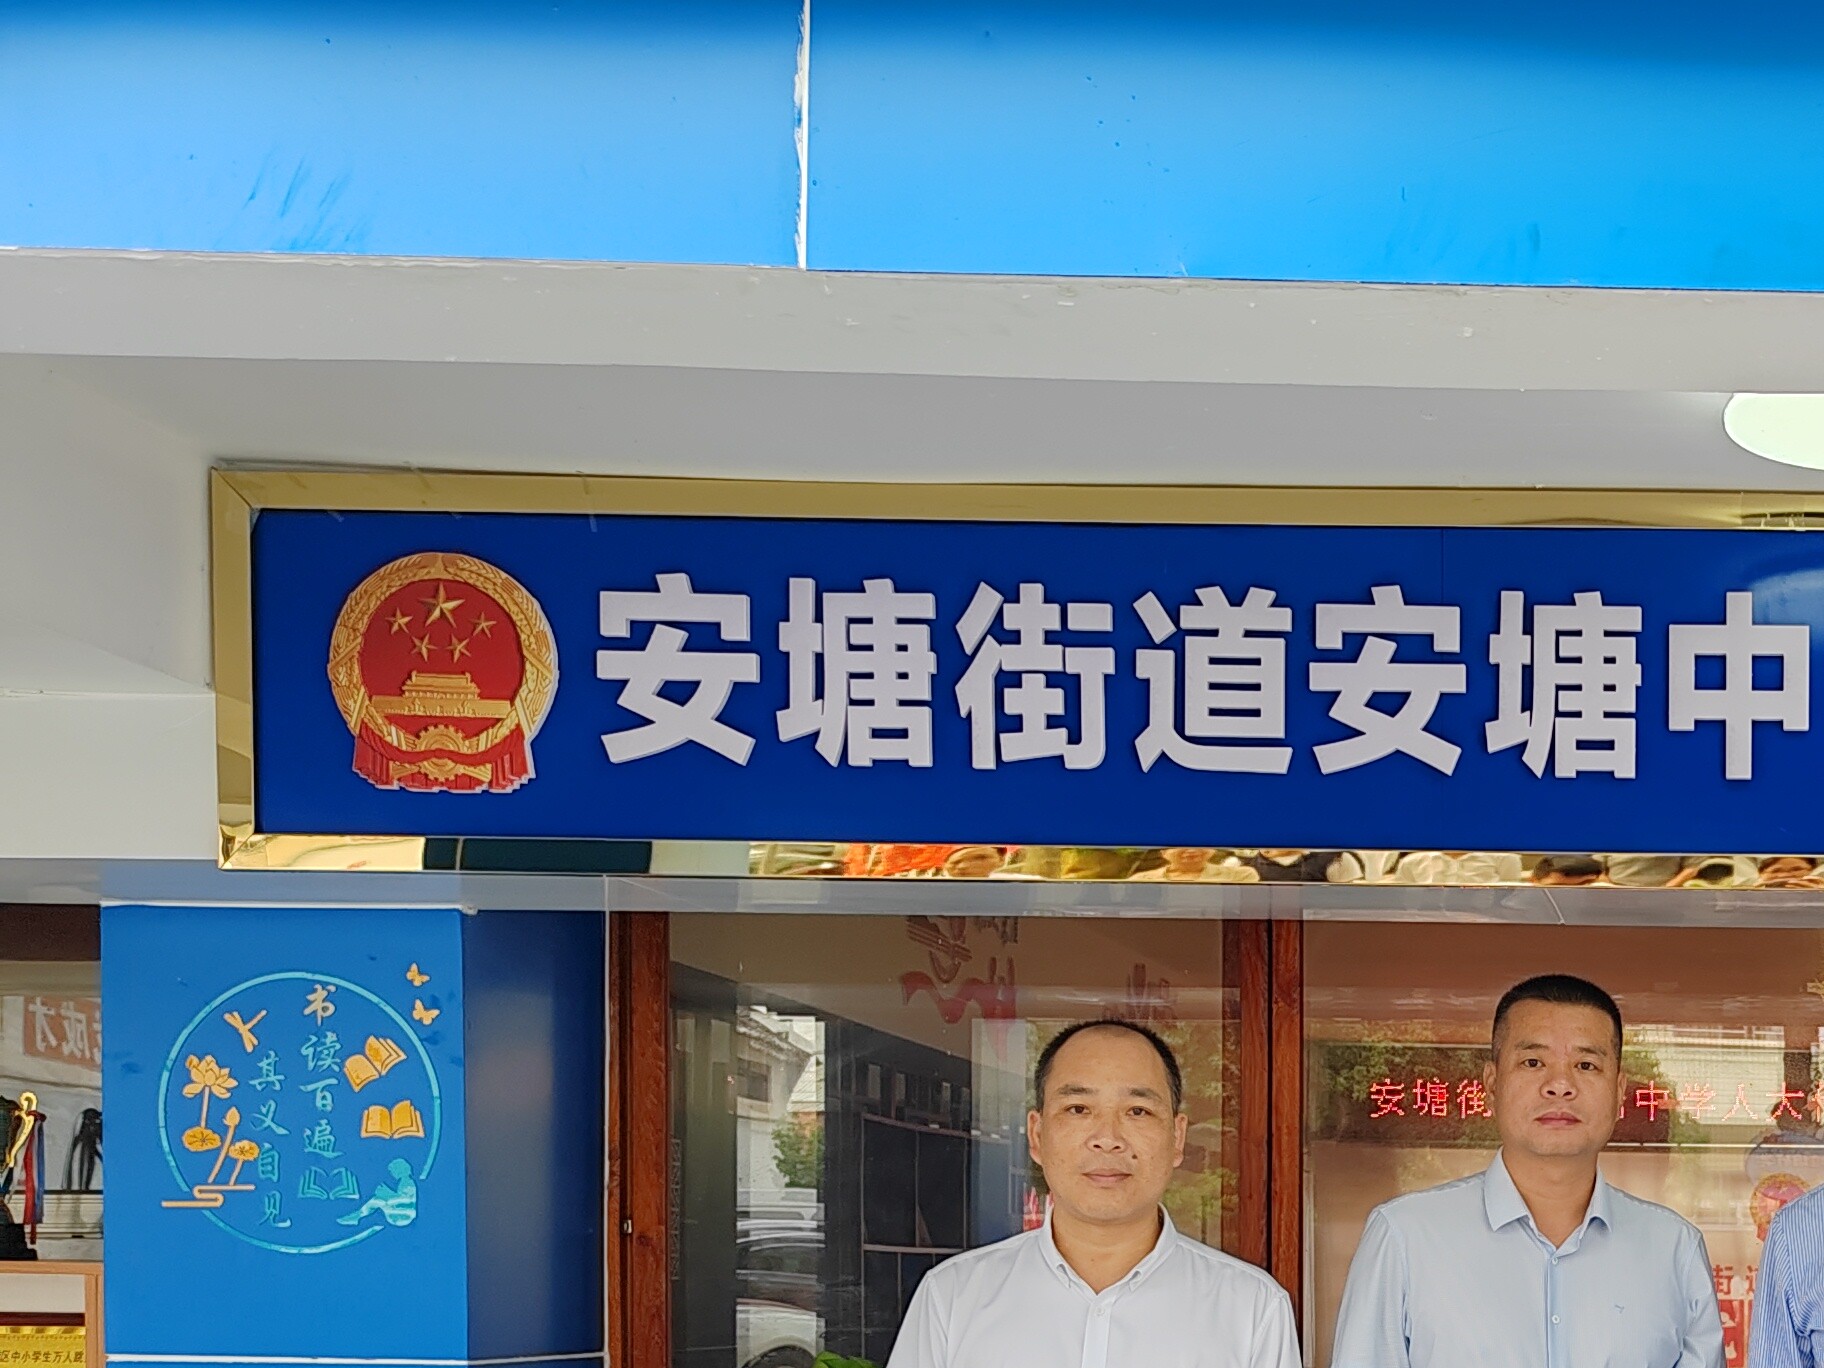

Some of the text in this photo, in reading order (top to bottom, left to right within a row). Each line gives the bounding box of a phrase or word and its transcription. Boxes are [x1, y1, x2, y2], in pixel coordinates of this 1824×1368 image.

[250, 1050, 293, 1228] 其义自见
[300, 984, 345, 1160] 书读百遍
[0, 1351, 86, 1364] 区中小学生万人跳
